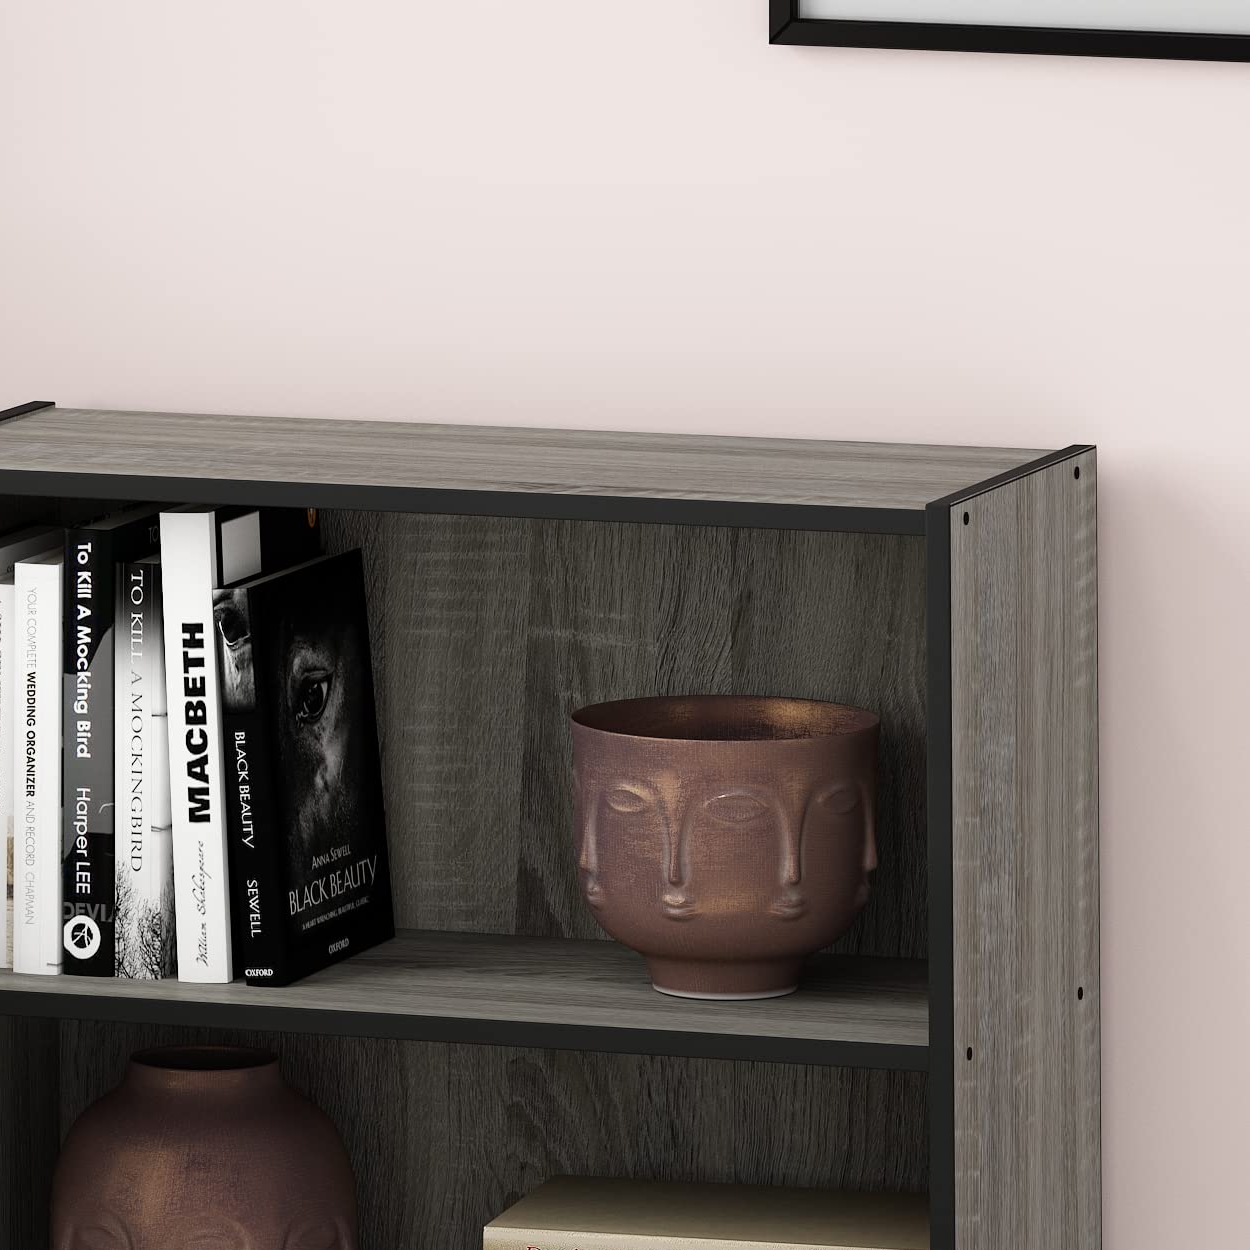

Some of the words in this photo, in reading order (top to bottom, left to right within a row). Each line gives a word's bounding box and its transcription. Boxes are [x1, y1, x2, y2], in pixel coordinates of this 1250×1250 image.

[77, 542, 92, 565] To
[26, 587, 38, 615] YOUR
[77, 571, 92, 599] Kill
[131, 569, 144, 605] TO
[77, 604, 92, 620] A
[26, 620, 38, 669] COMPLETE
[131, 612, 144, 664] KILL
[73, 625, 92, 714] Mocking
[131, 671, 143, 685] A
[26, 672, 37, 727] WEDDING
[181, 622, 211, 824] MACBETH
[25, 730, 36, 797] ORGANIZER
[76, 720, 91, 758] Bird
[234, 731, 250, 782] BLACK
[130, 693, 143, 872] MOCKINGBIRD
[25, 801, 36, 824] AND
[73, 787, 91, 857] Harper
[238, 784, 255, 849] BEAUTY
[25, 826, 36, 867] RECORD
[24, 871, 36, 926] CHAPMAN
[76, 862, 91, 894] LEE
[288, 877, 329, 916] BLACK
[330, 855, 377, 898] BEAUTY
[246, 879, 262, 938] SEWELL
[245, 968, 274, 978] OXFORD
